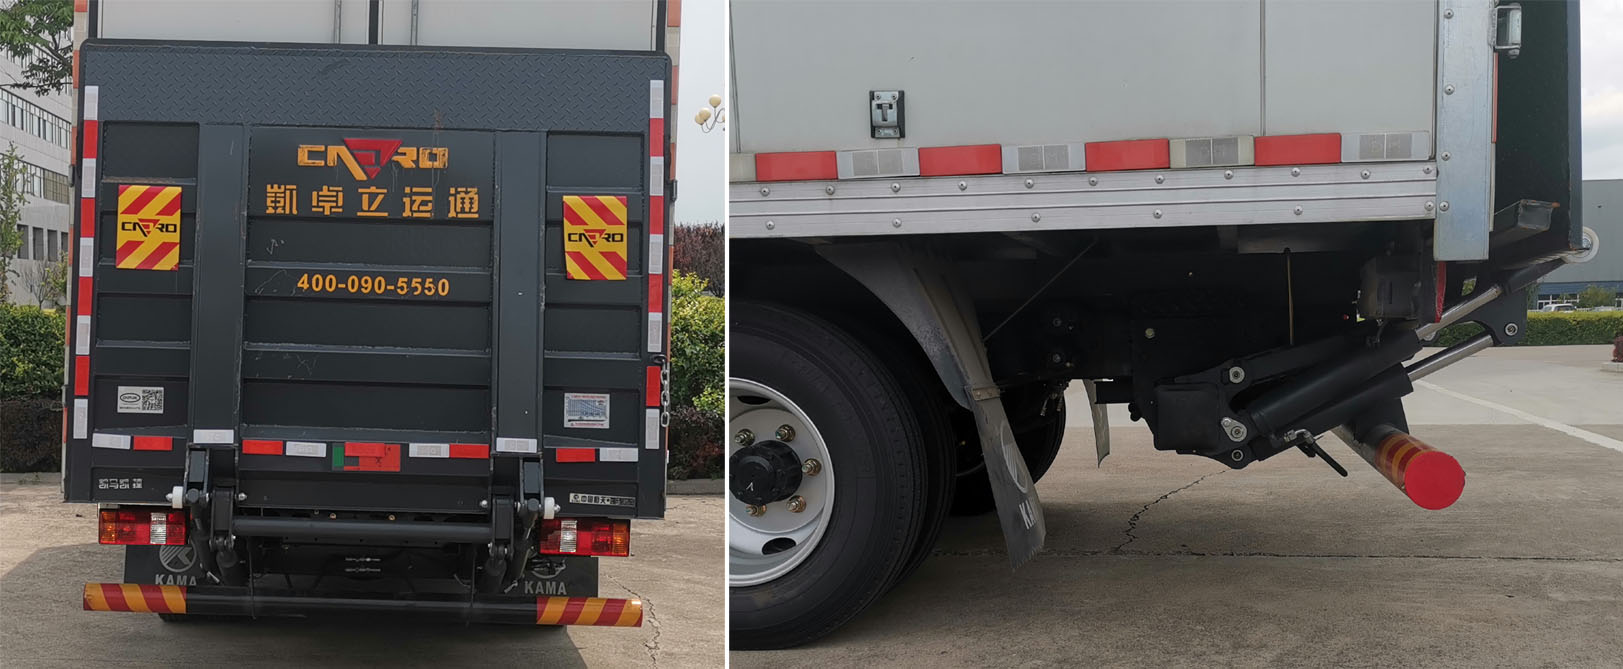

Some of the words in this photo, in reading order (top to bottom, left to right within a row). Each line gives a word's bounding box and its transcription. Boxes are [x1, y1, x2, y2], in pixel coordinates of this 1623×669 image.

[297, 273, 450, 297] 400-090-5550
[155, 574, 197, 586] KAMA
[524, 580, 567, 595] KAMA
